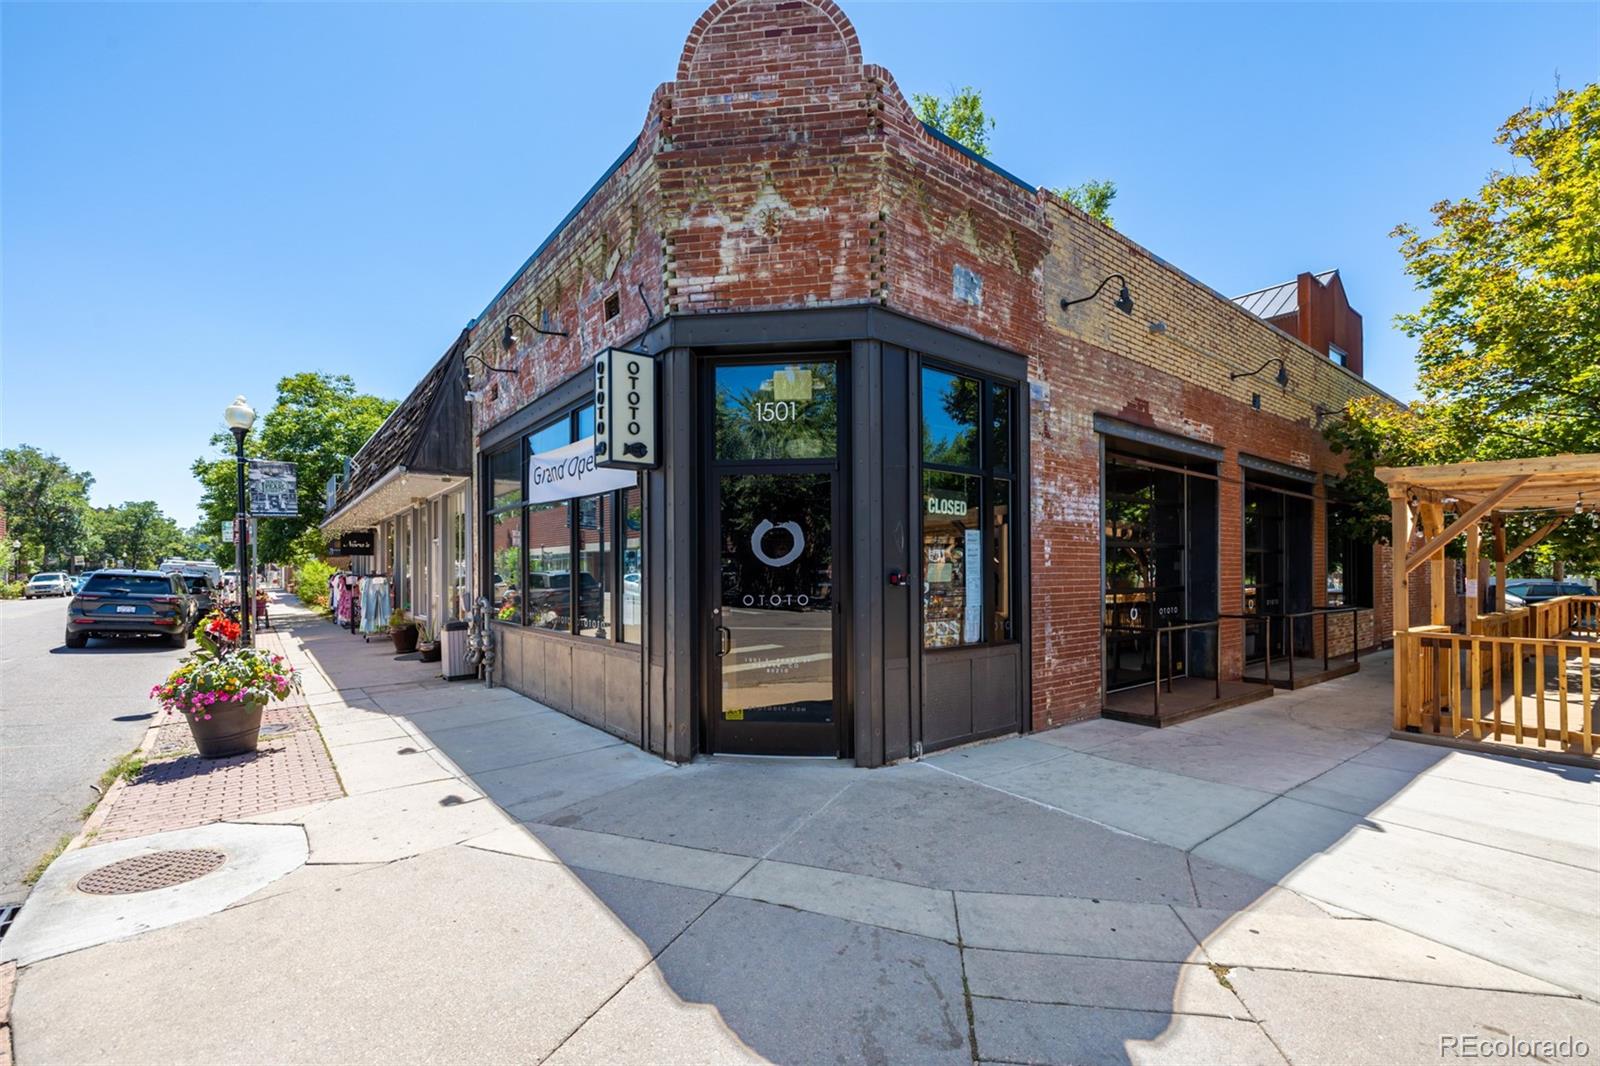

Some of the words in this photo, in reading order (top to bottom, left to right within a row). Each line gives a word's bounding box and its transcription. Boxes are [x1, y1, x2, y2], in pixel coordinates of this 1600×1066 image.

[597, 361, 605, 435] OTOTO
[627, 361, 641, 435] OTOTO
[755, 401, 796, 422] 1501
[533, 458, 567, 486] Grand
[928, 497, 967, 516] CLOSED
[742, 594, 809, 606] OTOTO
